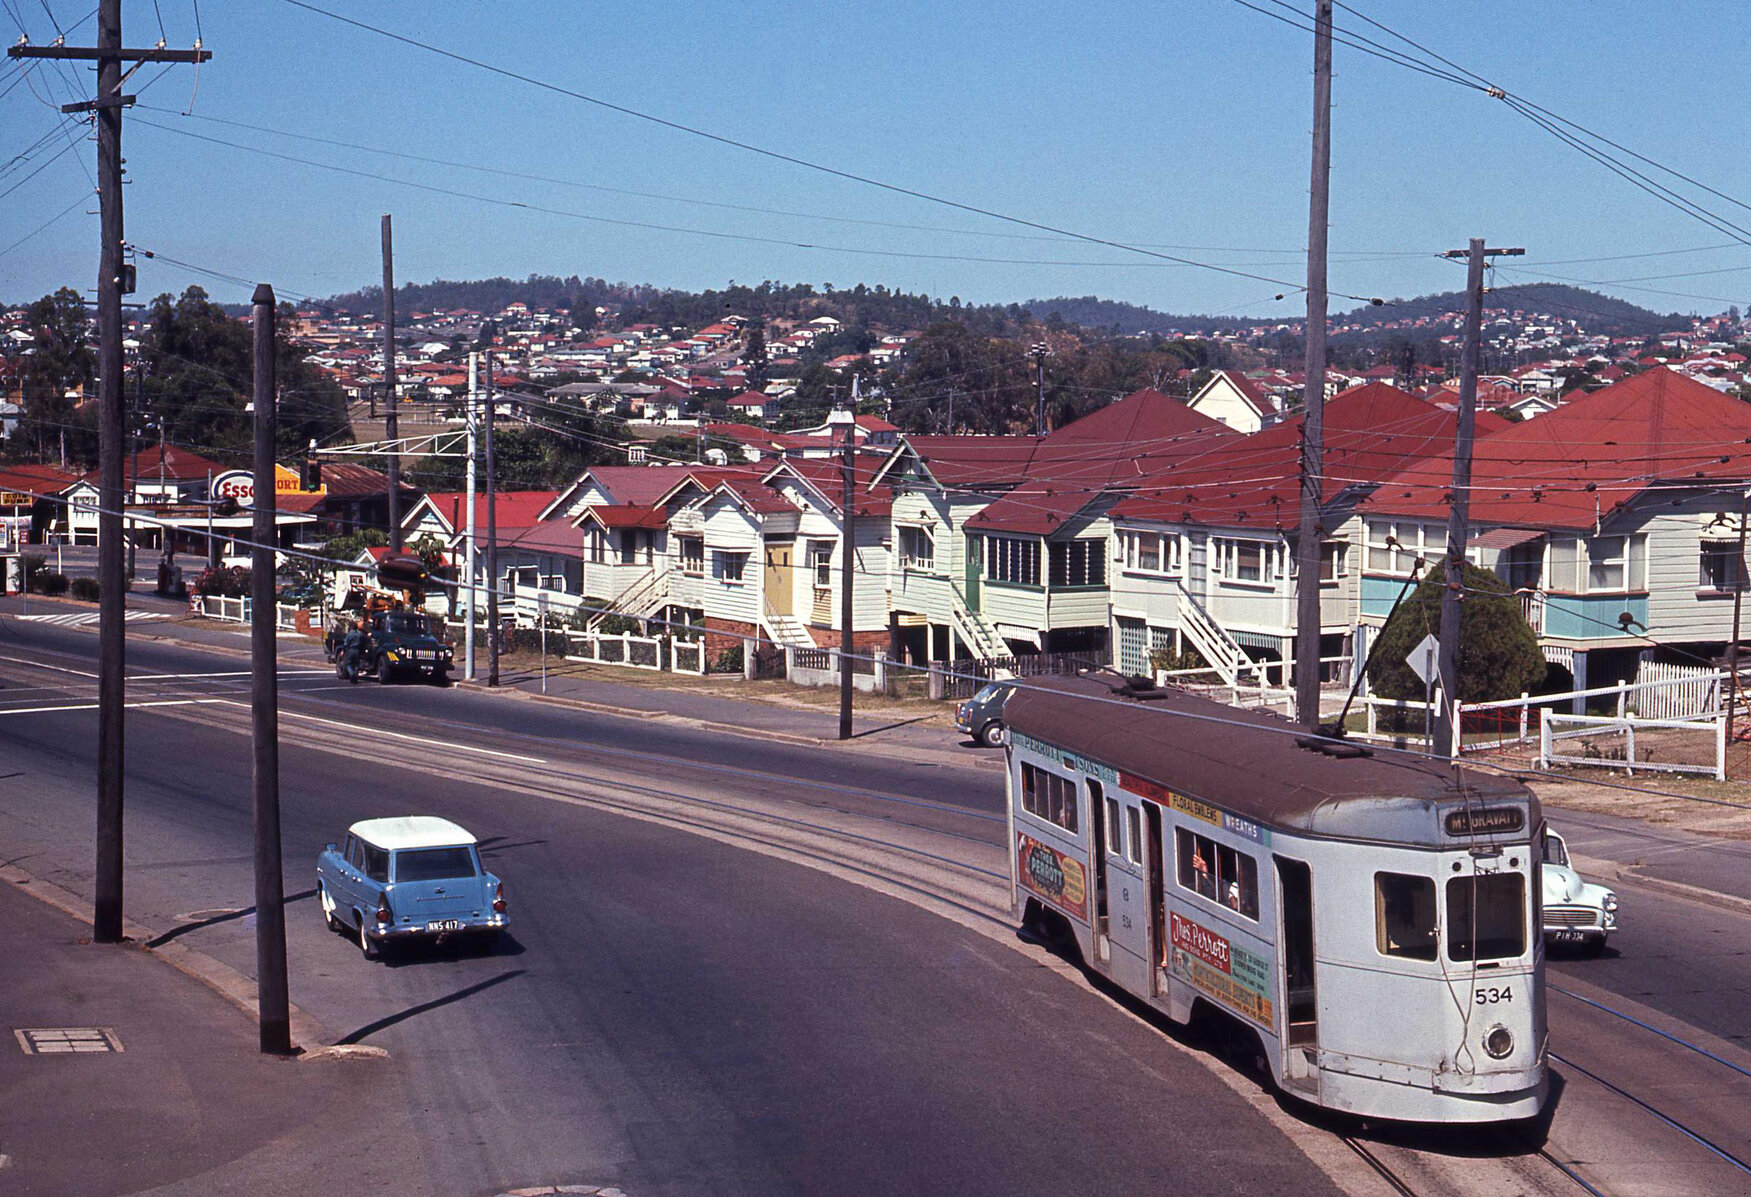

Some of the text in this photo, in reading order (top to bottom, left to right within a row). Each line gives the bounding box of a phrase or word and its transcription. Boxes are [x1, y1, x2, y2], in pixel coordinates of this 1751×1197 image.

[276, 480, 298, 490] ORT
[1225, 813, 1258, 838] WREATHS
[1192, 923, 1229, 962] Perrott
[1475, 986, 1513, 1005] 534
